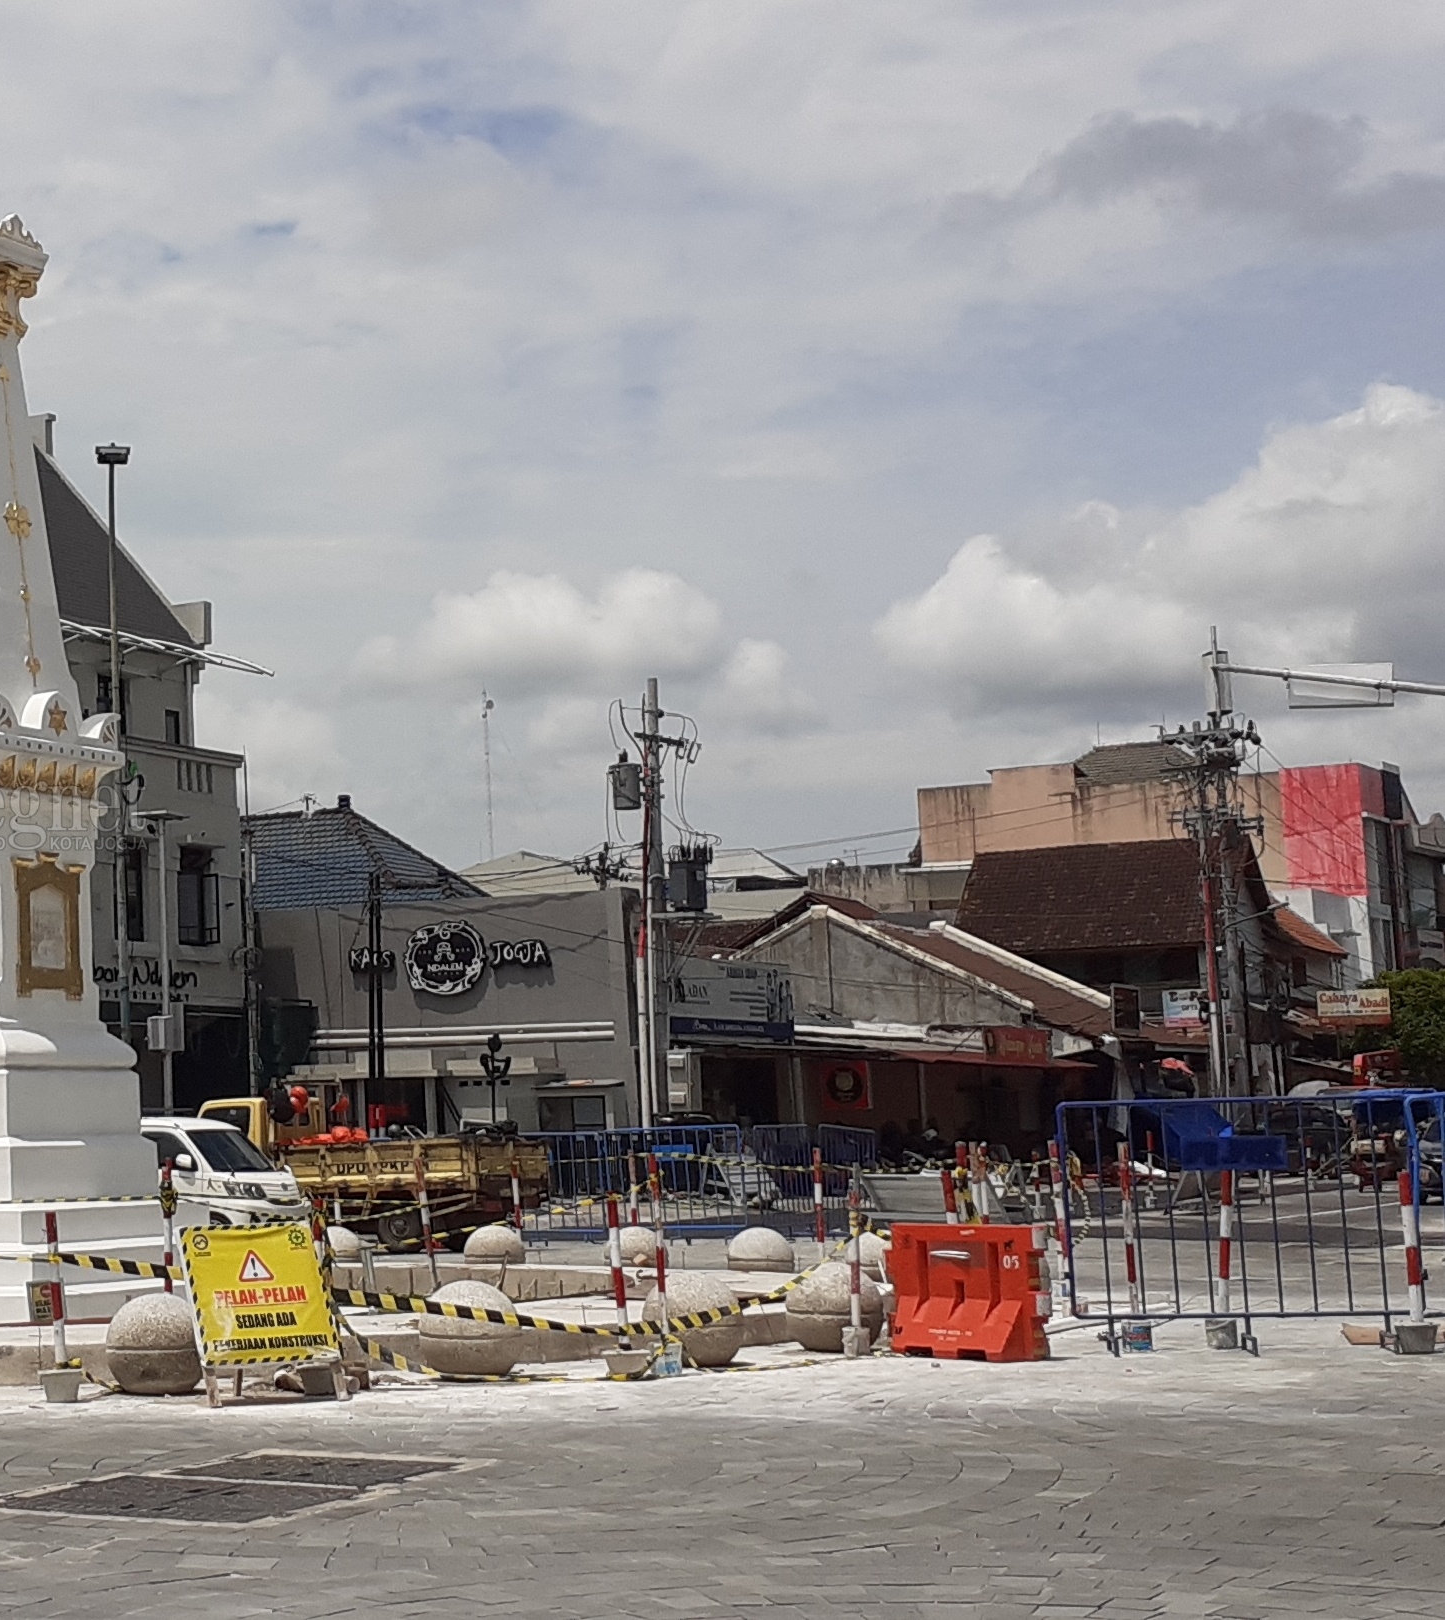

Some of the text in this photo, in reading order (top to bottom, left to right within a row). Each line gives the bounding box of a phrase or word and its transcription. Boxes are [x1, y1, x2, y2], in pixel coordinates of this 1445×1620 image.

[492, 938, 546, 966] JOGJA
[1359, 997, 1389, 1008] Abadi
[1002, 1255, 1020, 1270] 05
[214, 1285, 307, 1308] PELAN-PELAN
[235, 1311, 297, 1329] SEDANG ADA
[267, 1334, 329, 1348] KONSTRUKSI
